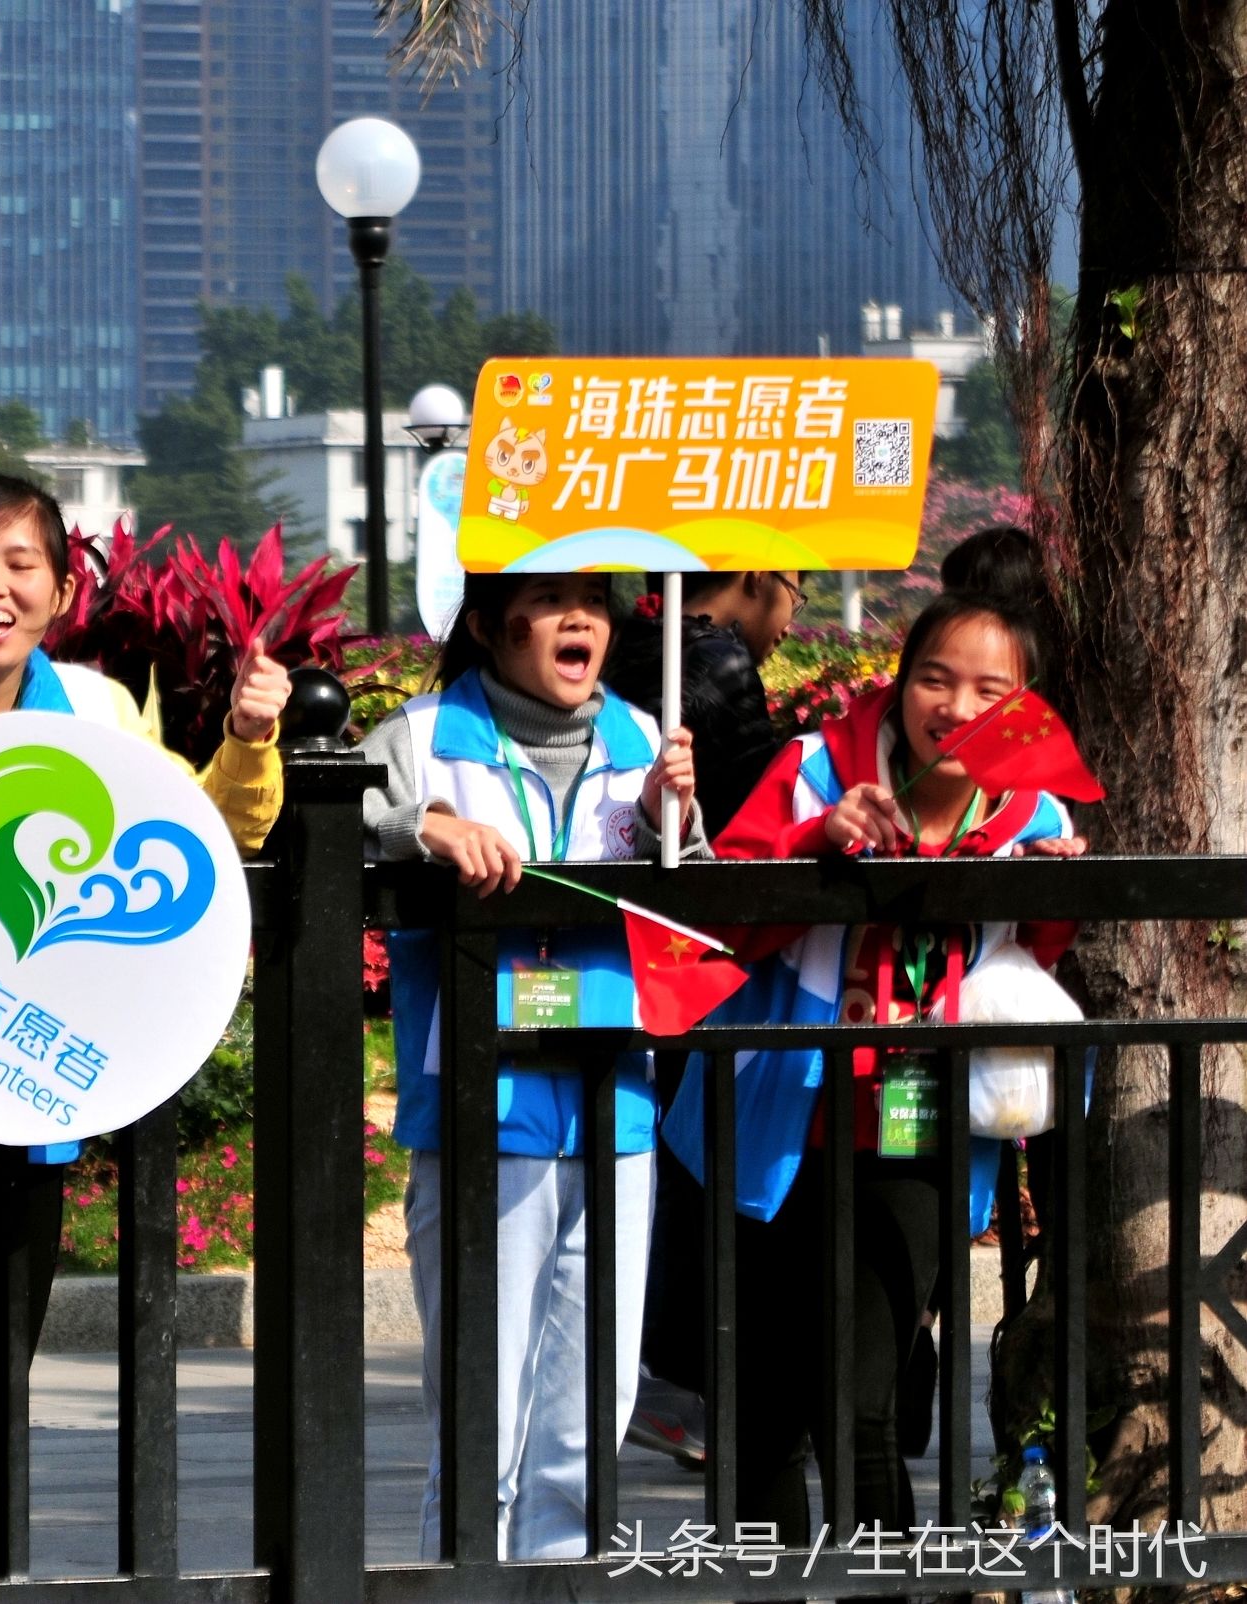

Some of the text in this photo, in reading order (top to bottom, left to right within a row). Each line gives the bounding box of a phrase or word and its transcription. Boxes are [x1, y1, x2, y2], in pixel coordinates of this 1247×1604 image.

[564, 376, 848, 440] 海珠志愿者
